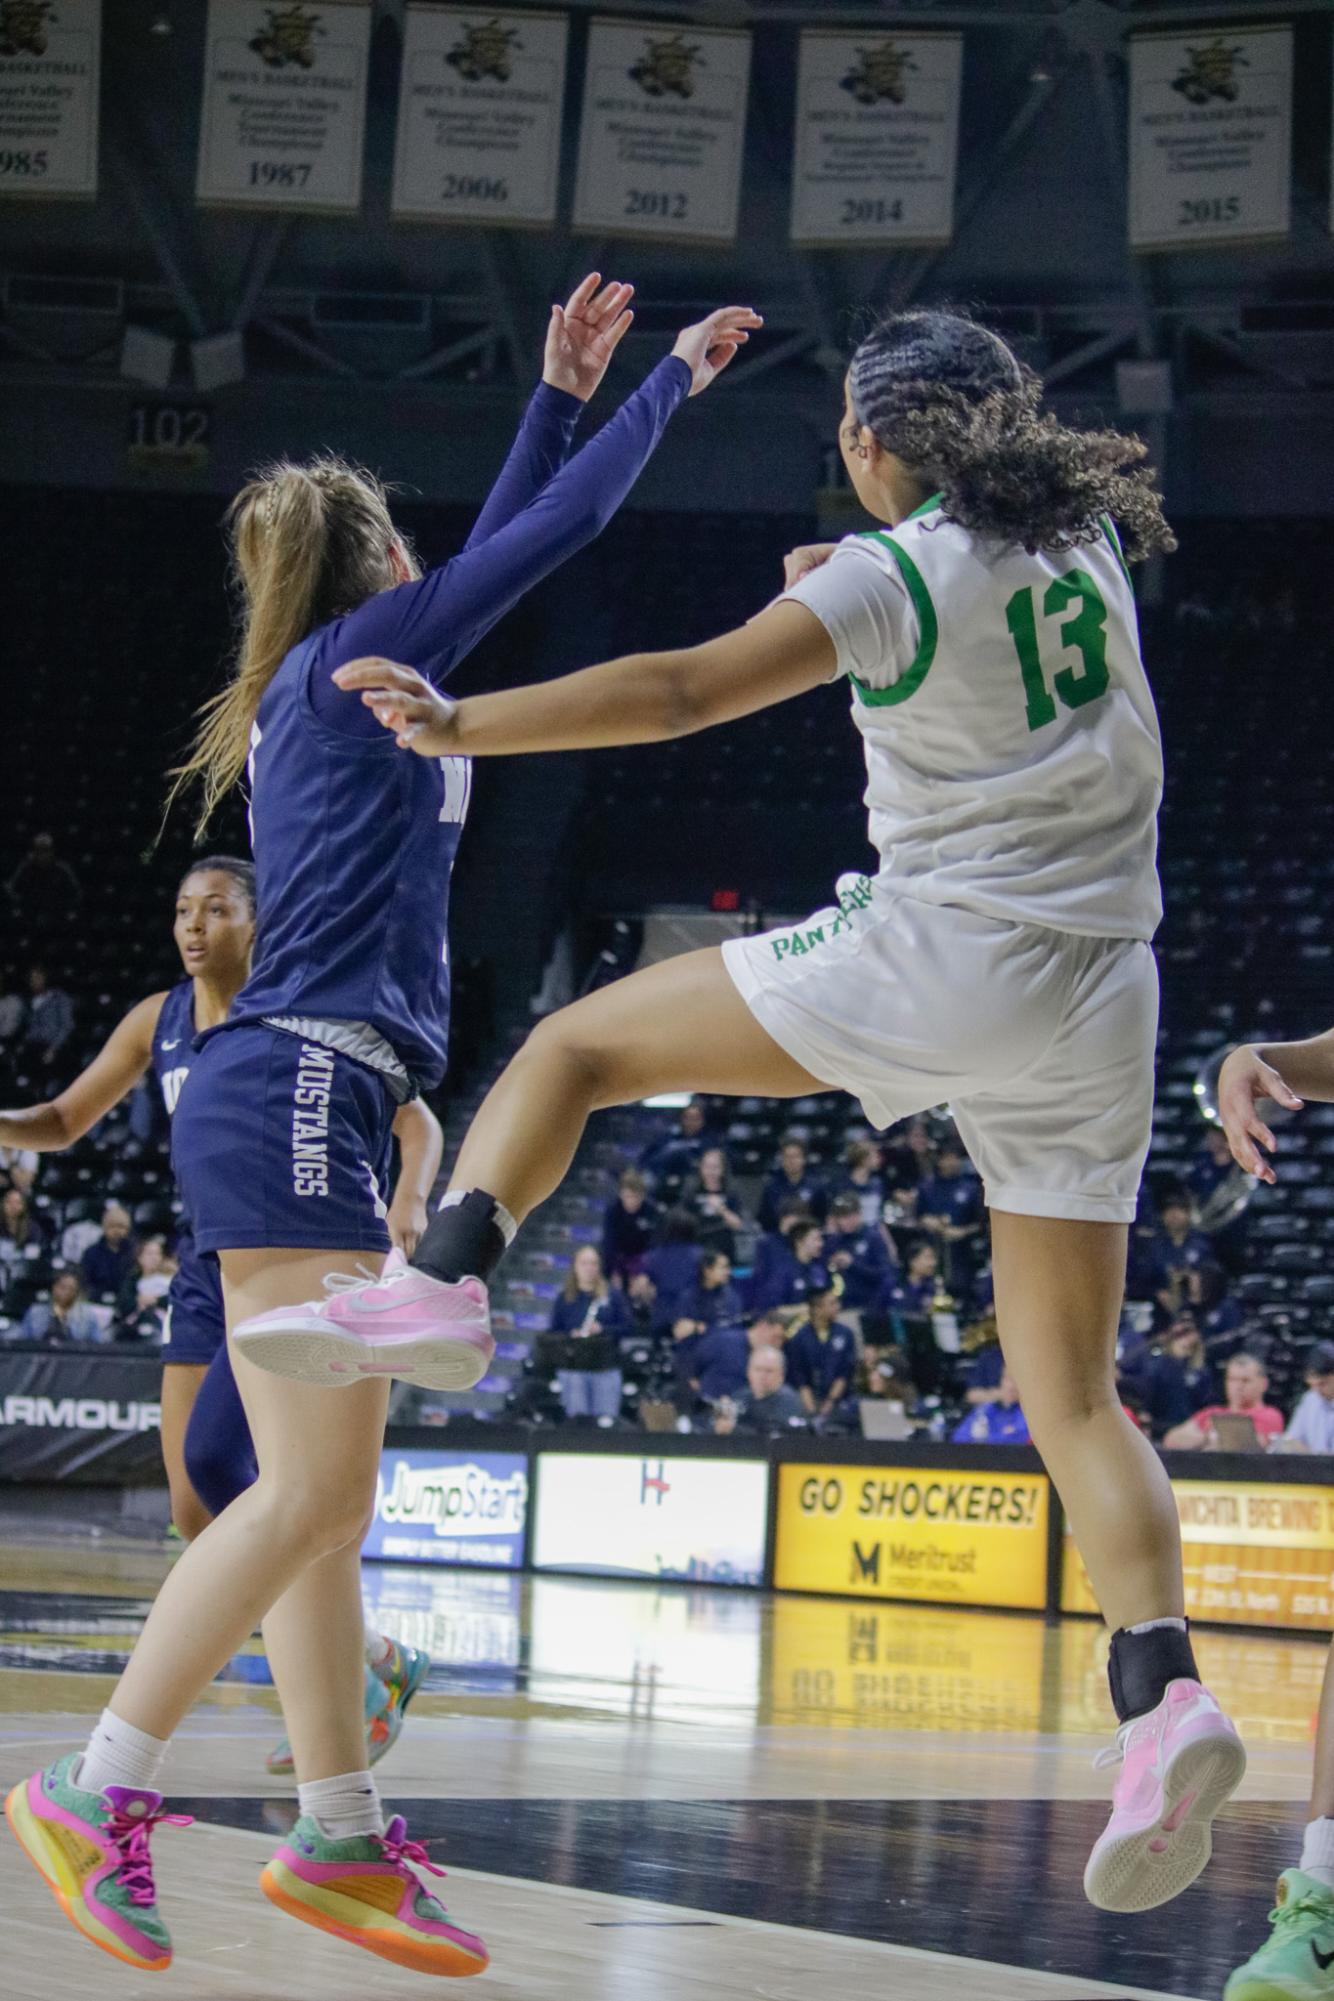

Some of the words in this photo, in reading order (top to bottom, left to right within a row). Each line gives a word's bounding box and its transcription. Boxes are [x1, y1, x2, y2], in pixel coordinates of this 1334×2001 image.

[249, 160, 313, 187] 1987
[442, 174, 508, 202] 2006
[623, 189, 689, 218] 2012
[841, 199, 904, 225] 2014
[1177, 197, 1240, 227] 2015
[134, 406, 209, 453] 102
[1005, 568, 1110, 732] 13
[292, 1043, 335, 1197] MUSTANGS
[0, 1395, 162, 1432] RMOUR
[385, 1466, 525, 1527] JumpStart
[800, 1477, 841, 1512] GO
[858, 1480, 1038, 1526] SHOCKERS!
[889, 1543, 977, 1574] Meritrust
